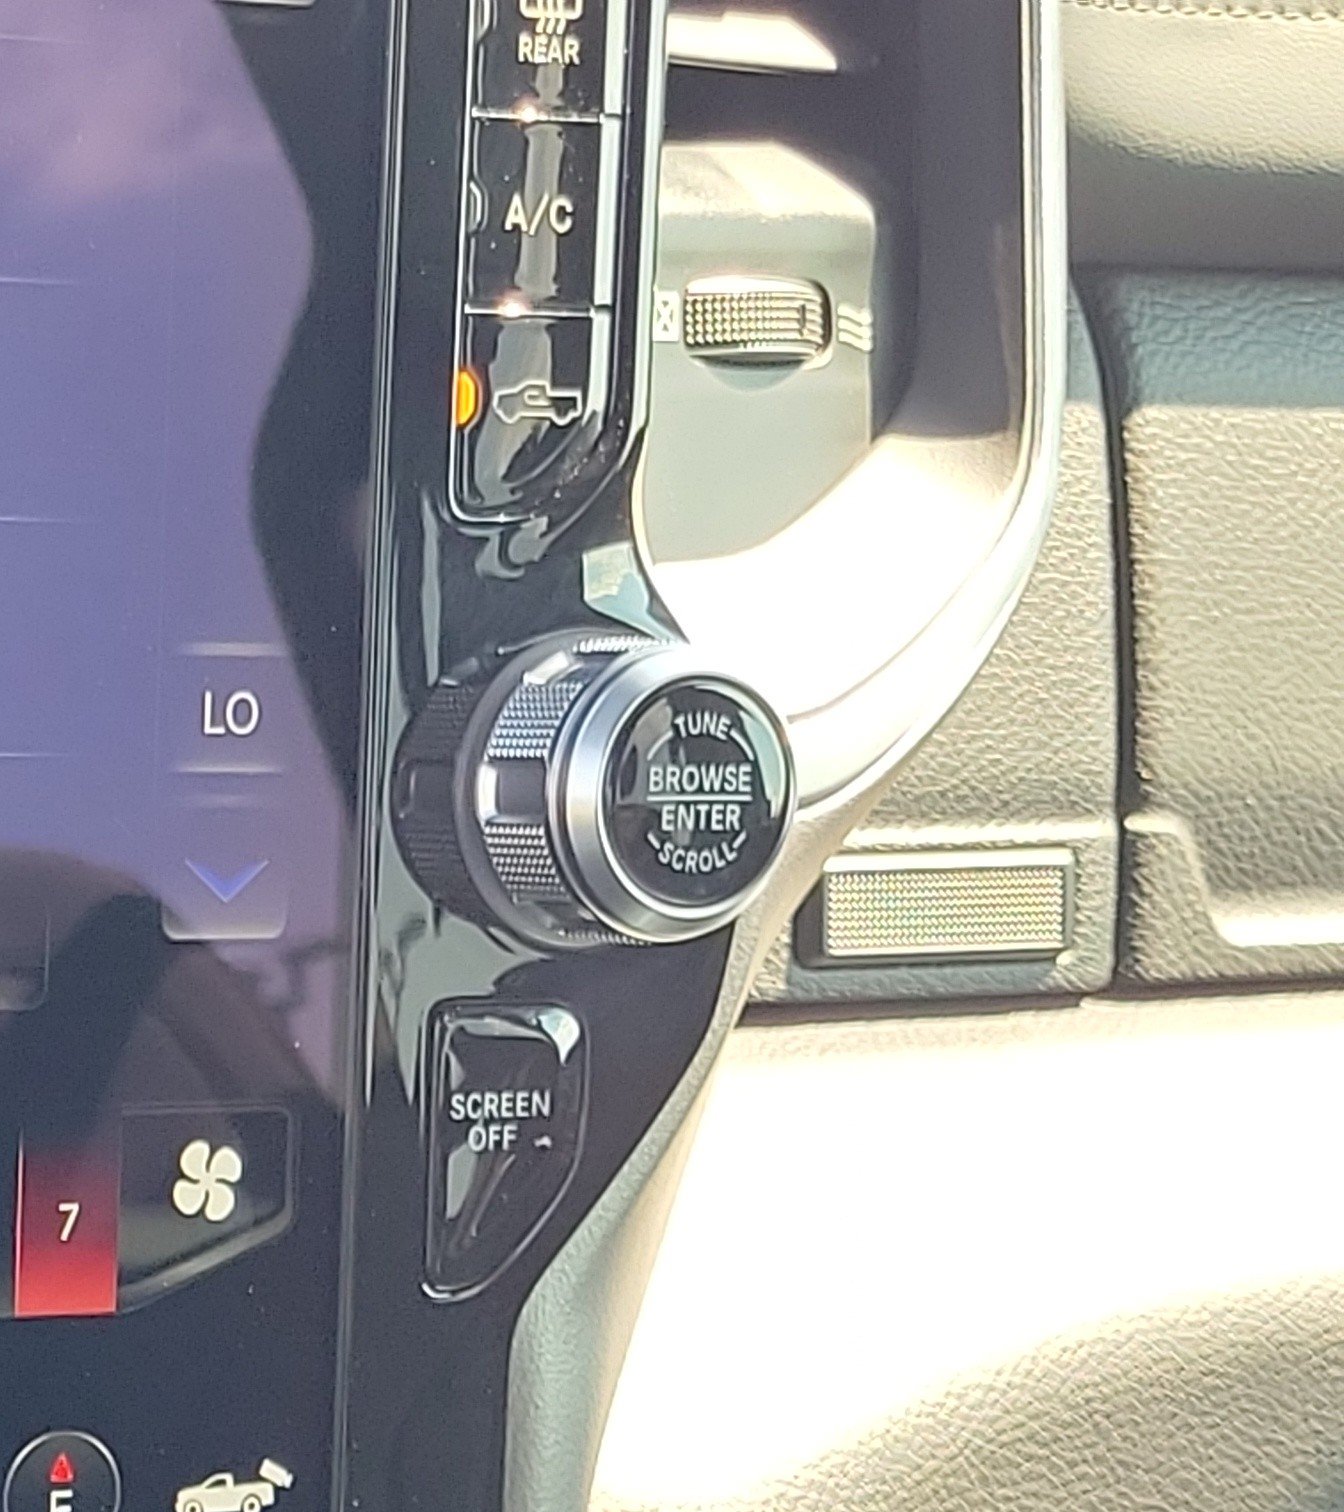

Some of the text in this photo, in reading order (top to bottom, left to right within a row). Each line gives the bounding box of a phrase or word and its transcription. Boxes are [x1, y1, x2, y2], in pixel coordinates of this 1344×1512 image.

[518, 36, 580, 66] REAR
[504, 193, 574, 237] A/C
[203, 690, 260, 736] LO
[673, 711, 730, 740] TUNE
[649, 765, 752, 793] BROWSE
[660, 804, 741, 833] ENTER
[657, 841, 738, 874] SCROLL
[450, 1090, 551, 1120] SCREEN
[468, 1124, 518, 1152] OFF
[57, 1202, 80, 1242] 7
